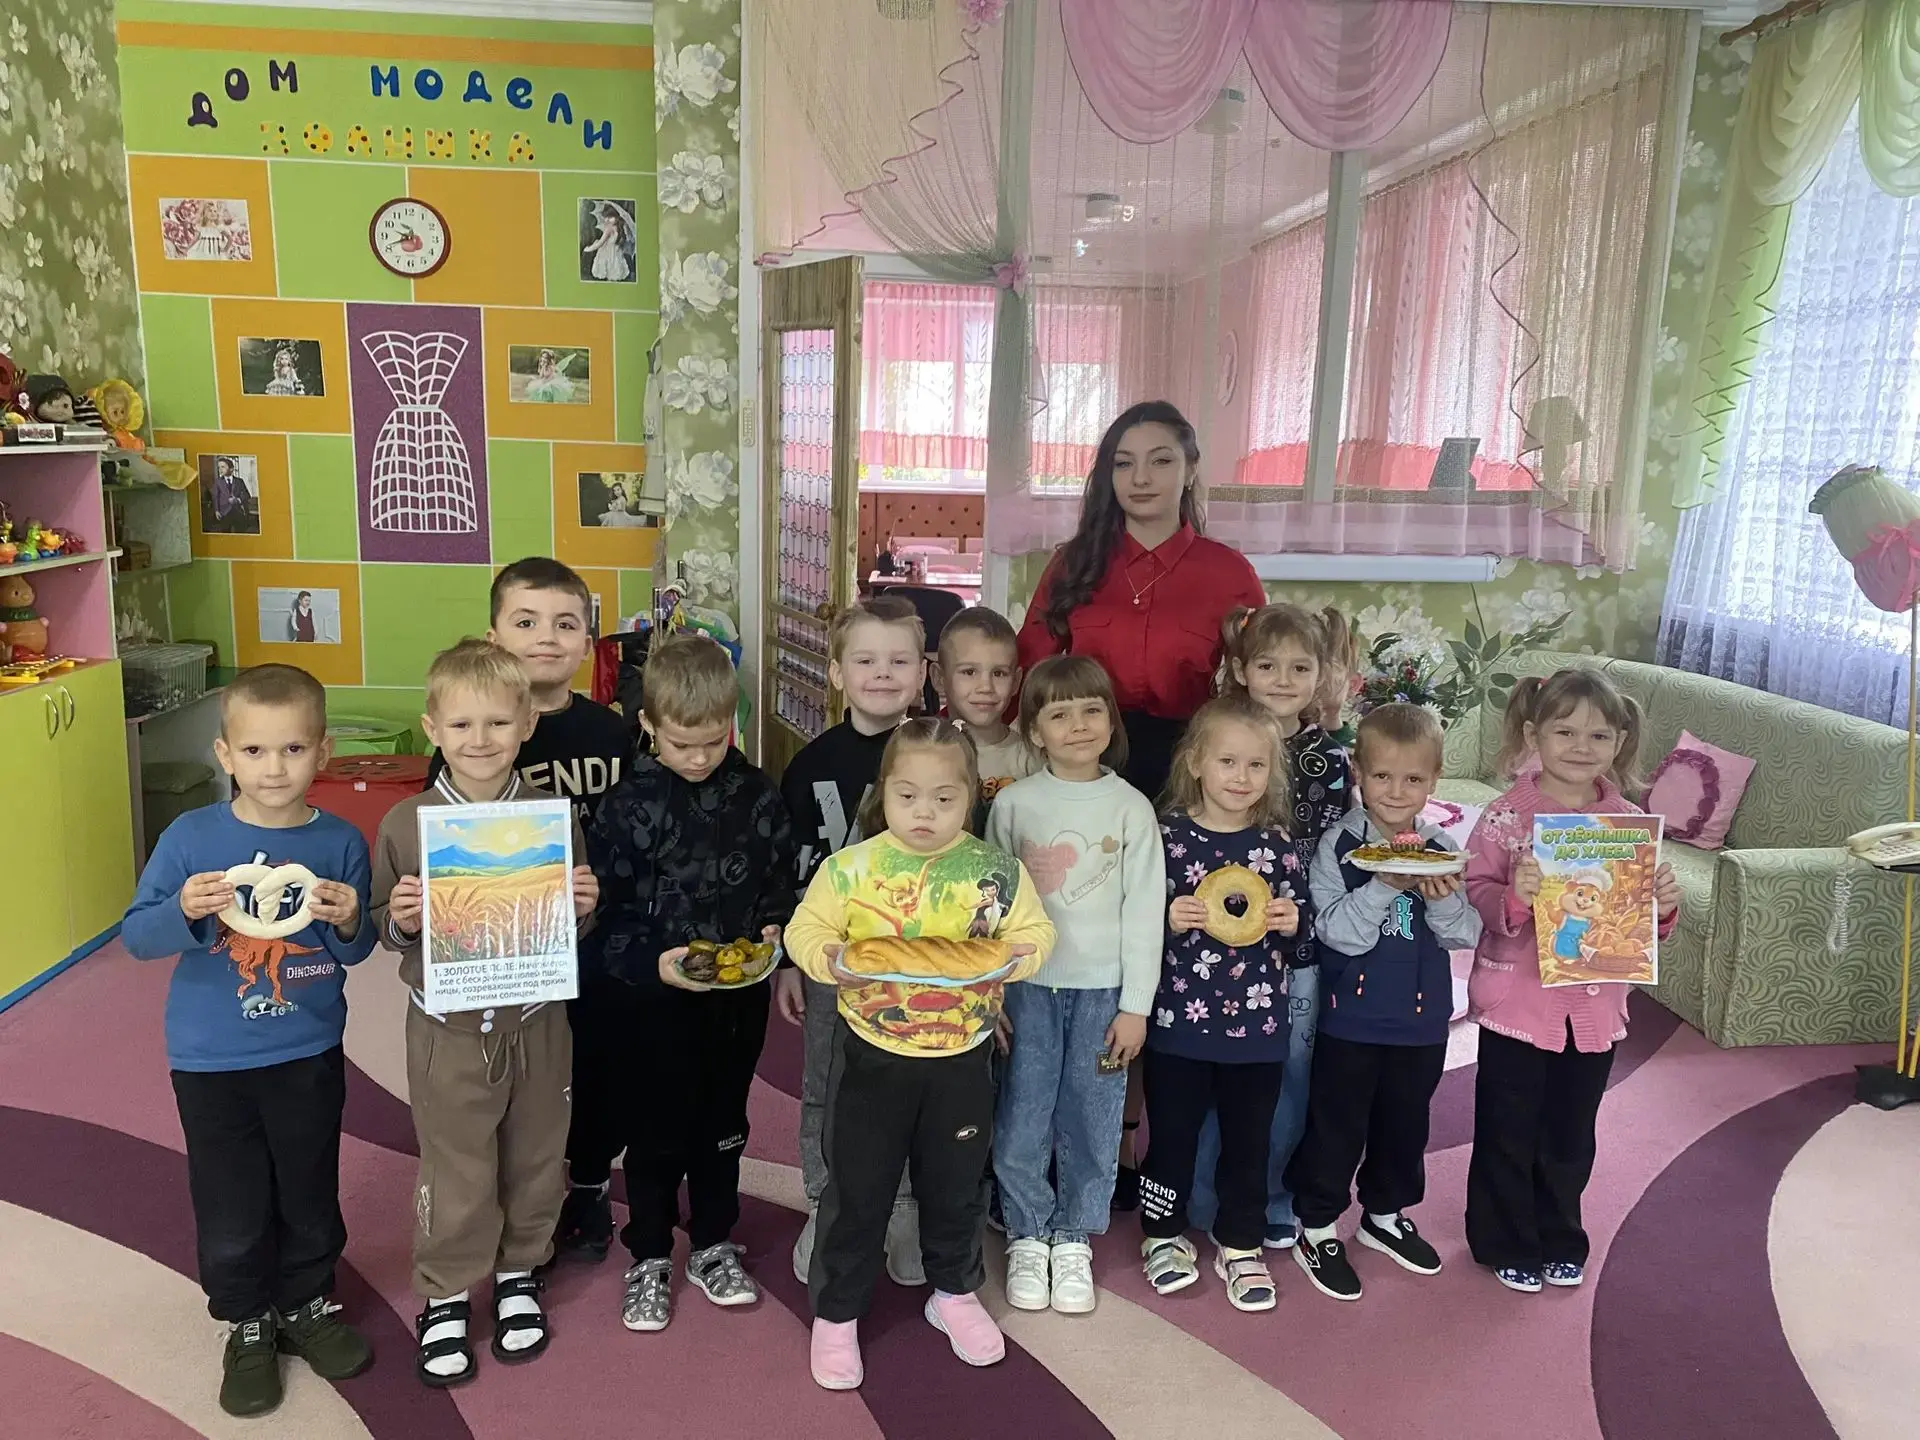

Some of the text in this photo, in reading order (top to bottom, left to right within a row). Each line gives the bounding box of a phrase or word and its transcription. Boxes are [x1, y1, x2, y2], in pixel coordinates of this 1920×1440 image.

[187, 59, 299, 128] ДОМ
[404, 208, 415, 217] 12
[384, 220, 394, 228] 10
[381, 232, 388, 240] 9
[521, 757, 620, 796] ENDI
[1541, 826, 1650, 844] ОТ ЗЁРНЫШКА
[1554, 845, 1636, 861] ДО ХЛЕБА
[286, 963, 336, 980] DINOSAUR
[434, 968, 442, 977] 1.
[444, 965, 488, 977] ЗОЛОТОЕ
[462, 980, 522, 994] созревающих
[523, 979, 539, 989] под
[1140, 1175, 1177, 1201] TREND
